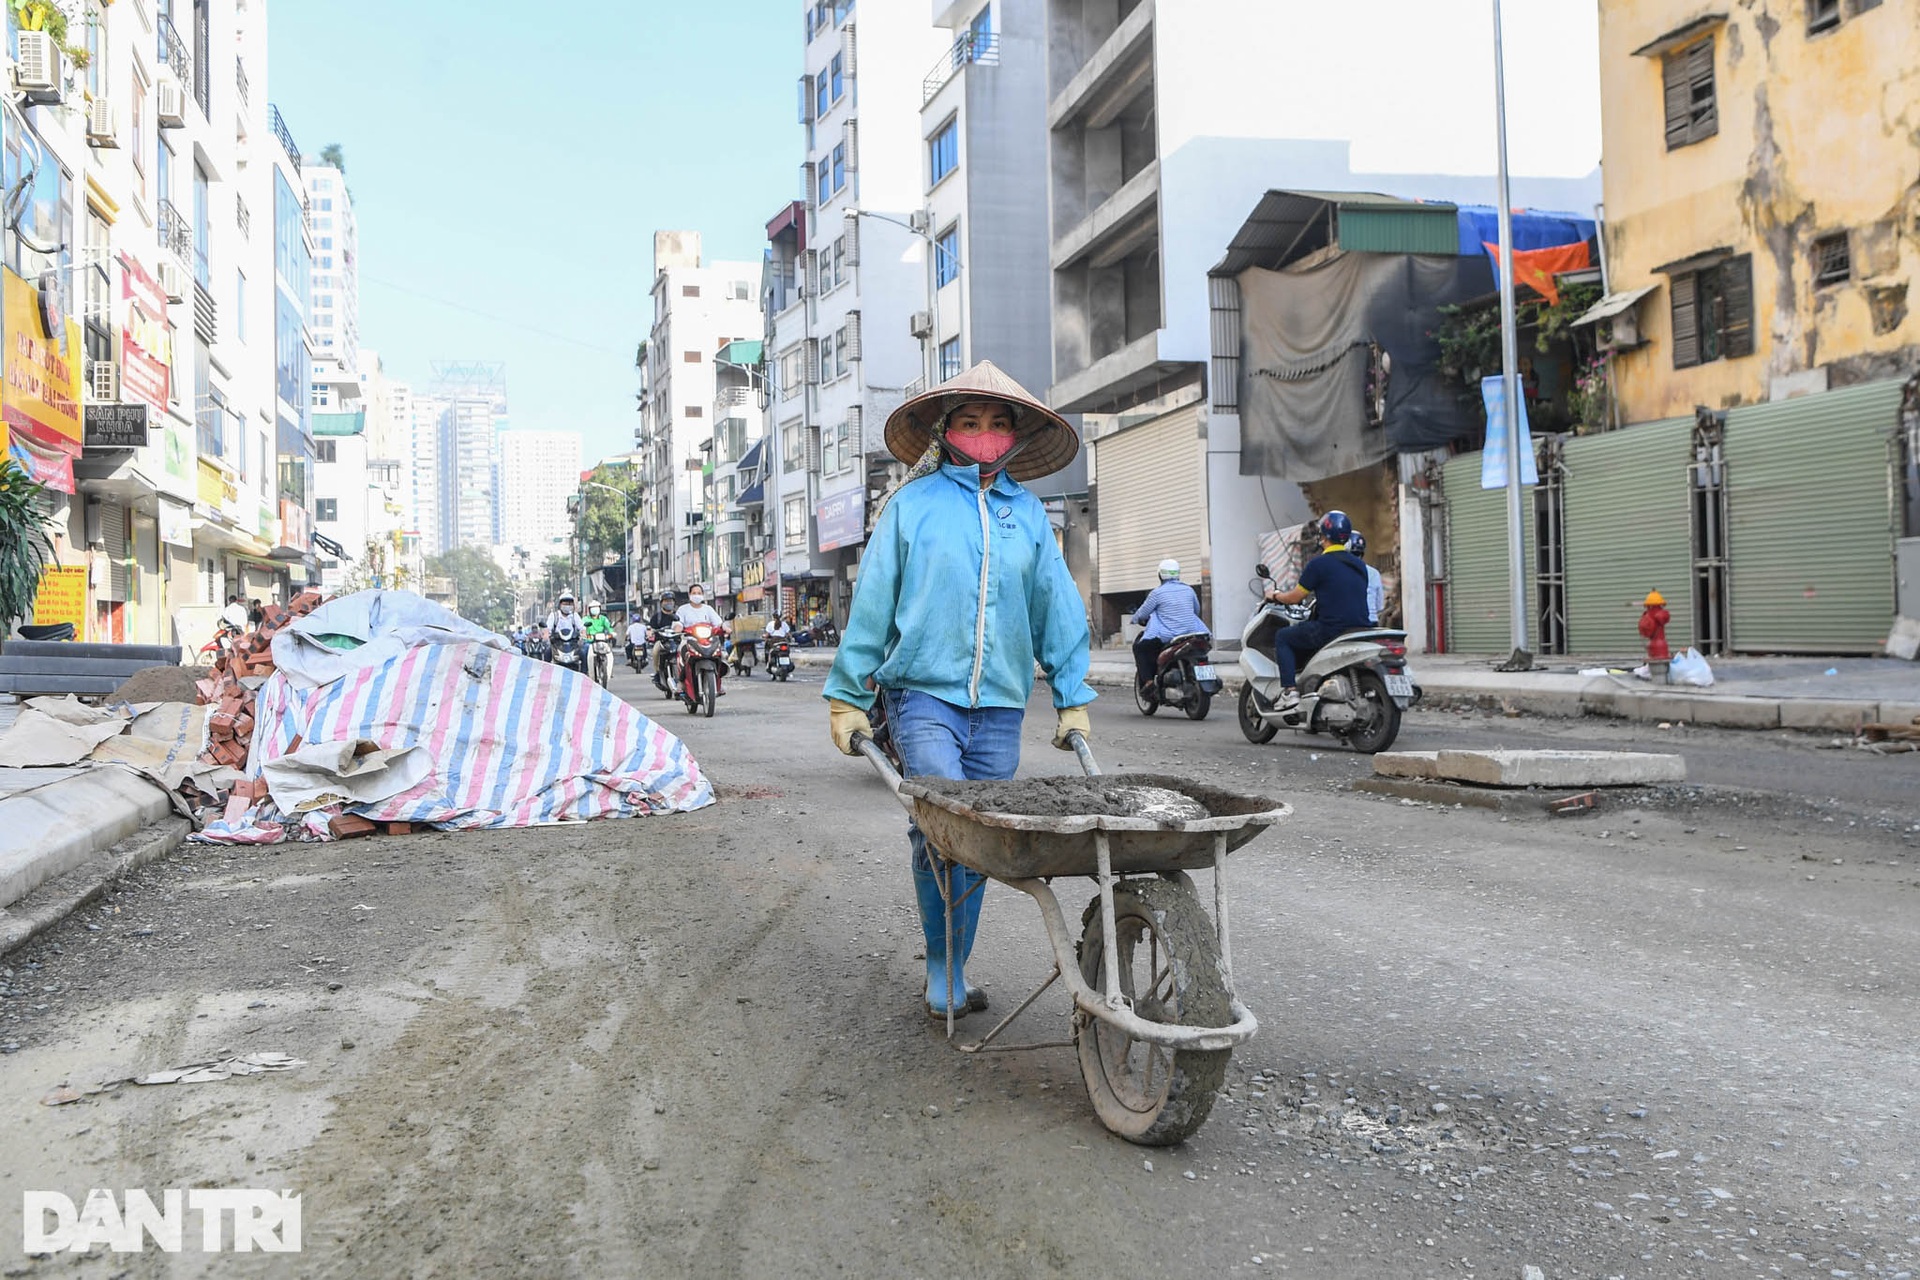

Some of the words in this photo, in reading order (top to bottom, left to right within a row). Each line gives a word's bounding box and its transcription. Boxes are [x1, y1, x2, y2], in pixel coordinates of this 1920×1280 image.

[86, 404, 115, 420] SẢN
[117, 408, 144, 423] PHỤ
[96, 420, 134, 432] KHOA
